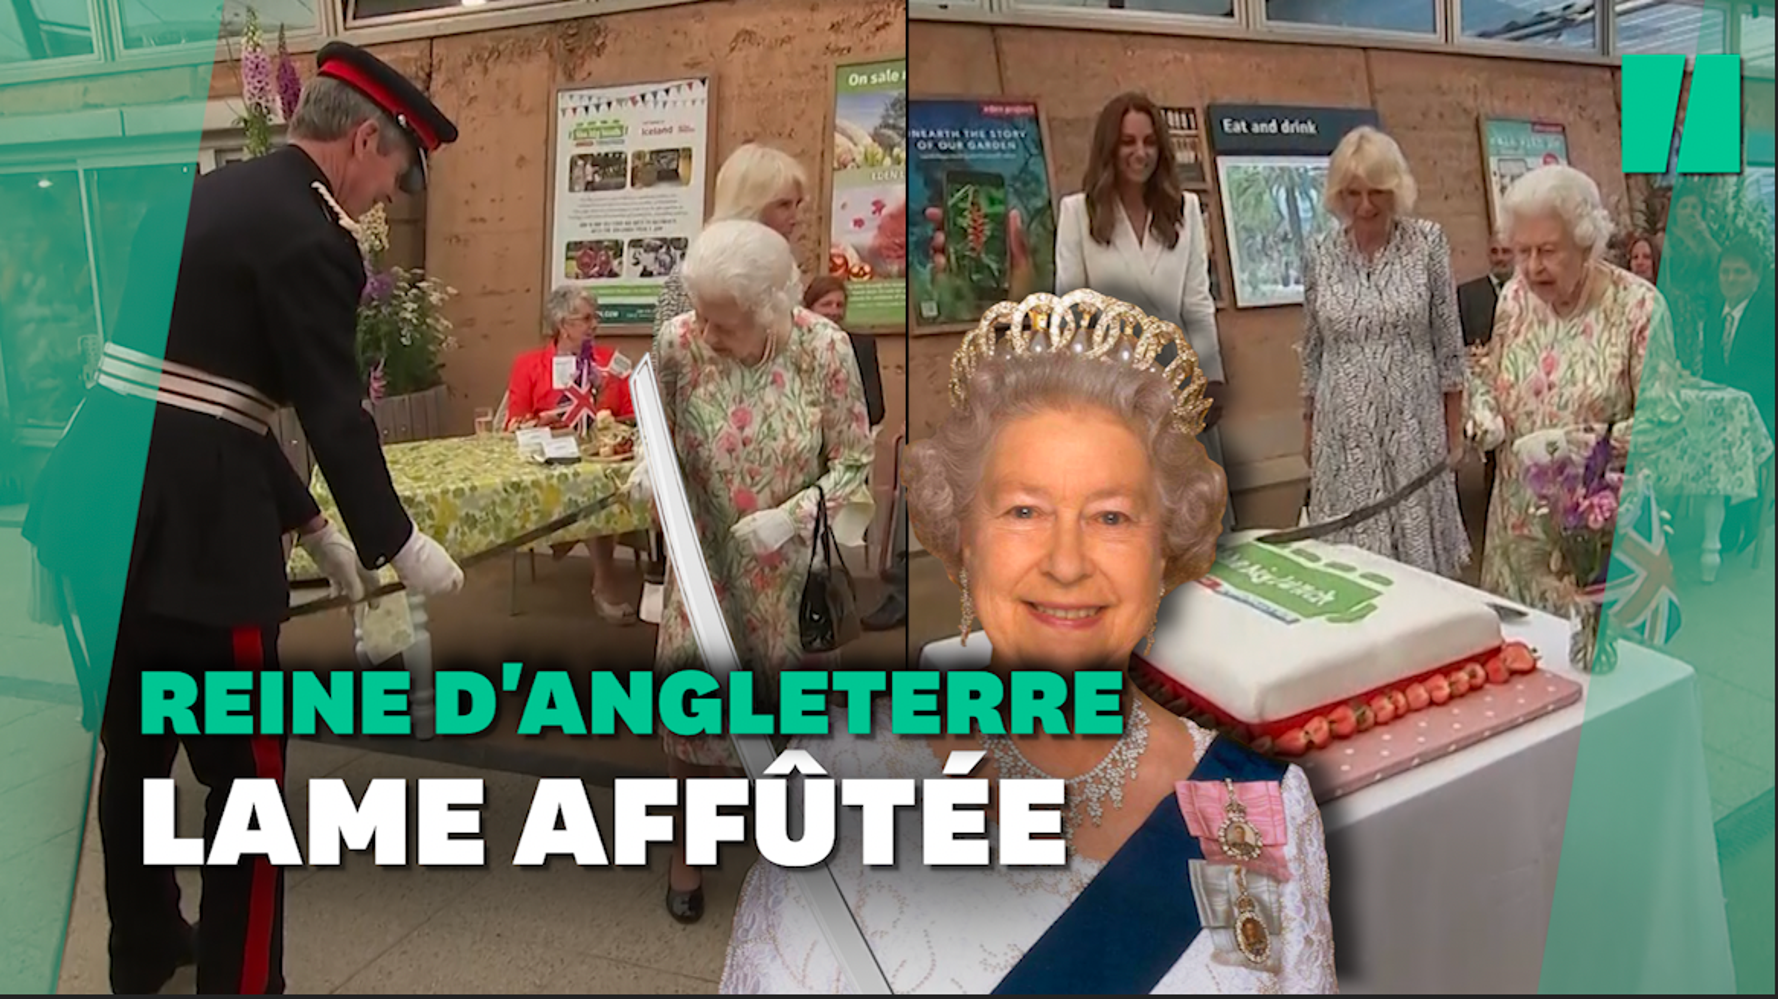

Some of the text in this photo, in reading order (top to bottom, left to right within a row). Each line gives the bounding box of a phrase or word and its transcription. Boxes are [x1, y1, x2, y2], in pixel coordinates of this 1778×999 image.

[848, 73, 867, 86] On
[870, 68, 900, 84] sale
[641, 126, 673, 136] Iceland
[1222, 118, 1317, 135] Eat and drink
[964, 130, 986, 138] THE
[989, 130, 1026, 139] STORY
[916, 140, 1017, 150] OF OUR GARDEN
